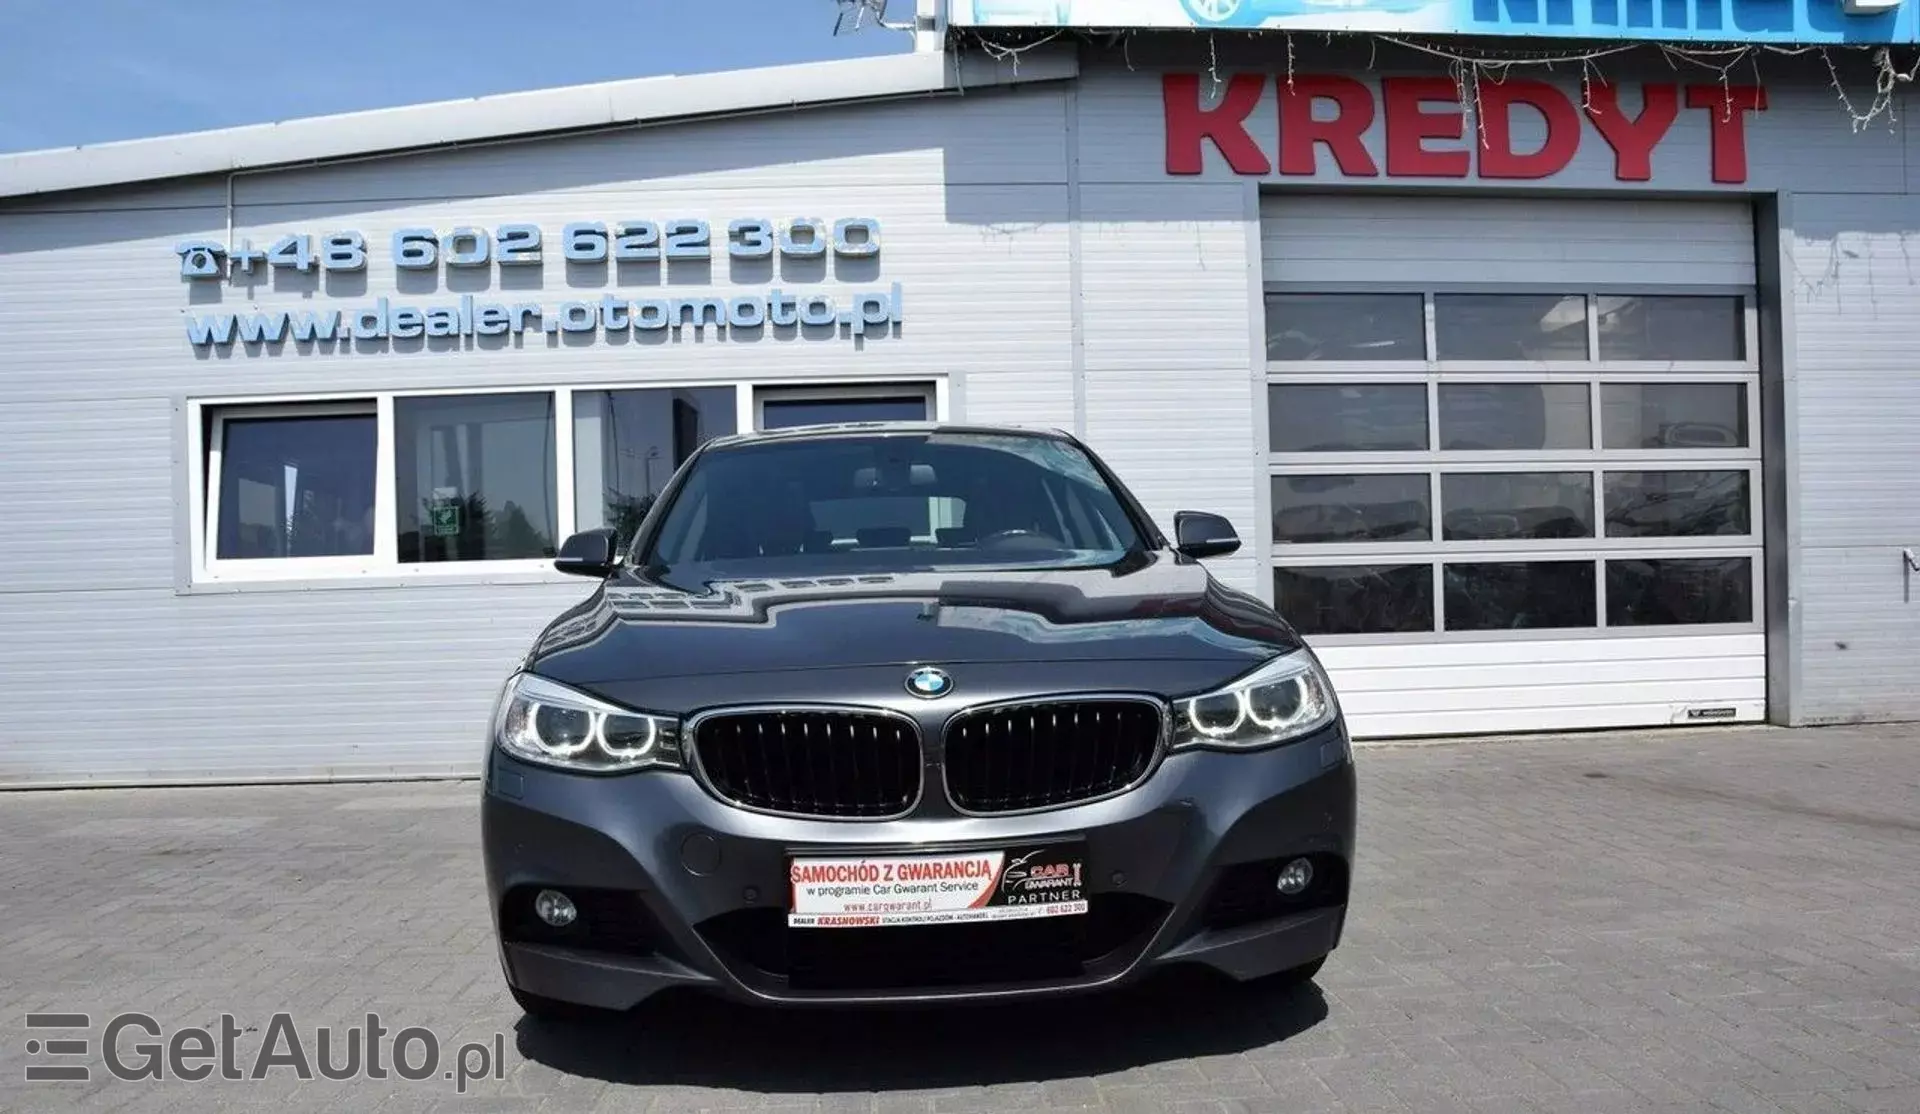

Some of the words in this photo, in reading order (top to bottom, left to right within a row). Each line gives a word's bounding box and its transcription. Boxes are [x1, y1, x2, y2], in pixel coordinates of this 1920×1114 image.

[1163, 74, 1768, 184] KREDYT
[231, 230, 367, 273] +48
[392, 224, 543, 269] 602
[562, 219, 711, 262] 622
[728, 217, 881, 257] 300
[184, 282, 902, 345] www.dealer.otomoto.pl
[791, 859, 879, 883] SAMOCHÓD
[883, 864, 893, 881] Z
[897, 859, 991, 881] GWARANCJĄ
[1030, 864, 1070, 877] CAR
[806, 887, 816, 895] w
[818, 885, 871, 898] programie
[873, 884, 891, 895] Car
[894, 883, 938, 894] Gwarant
[940, 880, 979, 892] Service
[1008, 890, 1081, 905] PARTNER
[817, 916, 881, 926] KRASNOWSKI
